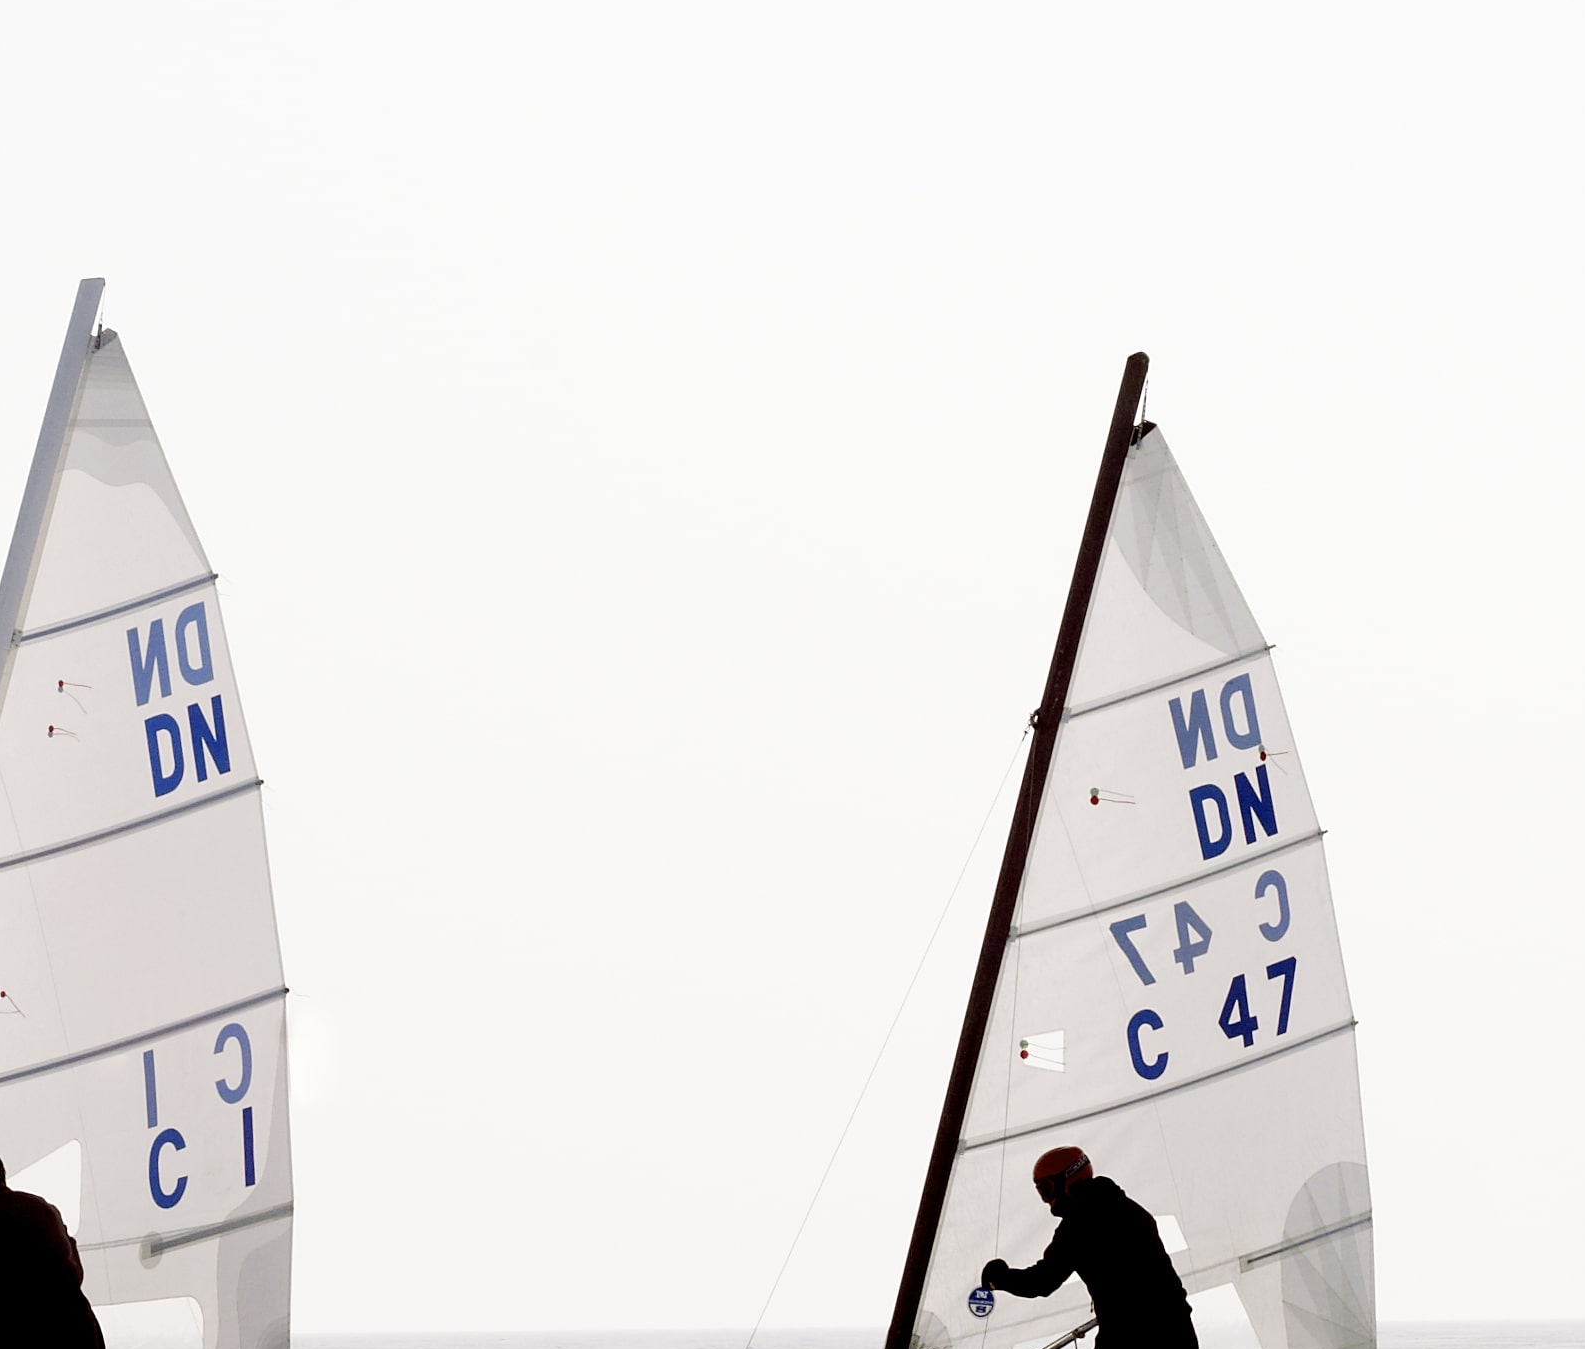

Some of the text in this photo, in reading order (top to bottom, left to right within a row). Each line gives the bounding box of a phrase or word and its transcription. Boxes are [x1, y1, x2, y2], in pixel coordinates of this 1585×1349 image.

[144, 695, 231, 797] DN
[1189, 765, 1278, 860] DN
[1128, 956, 1297, 1080] C 47
[149, 1128, 188, 1209] C
